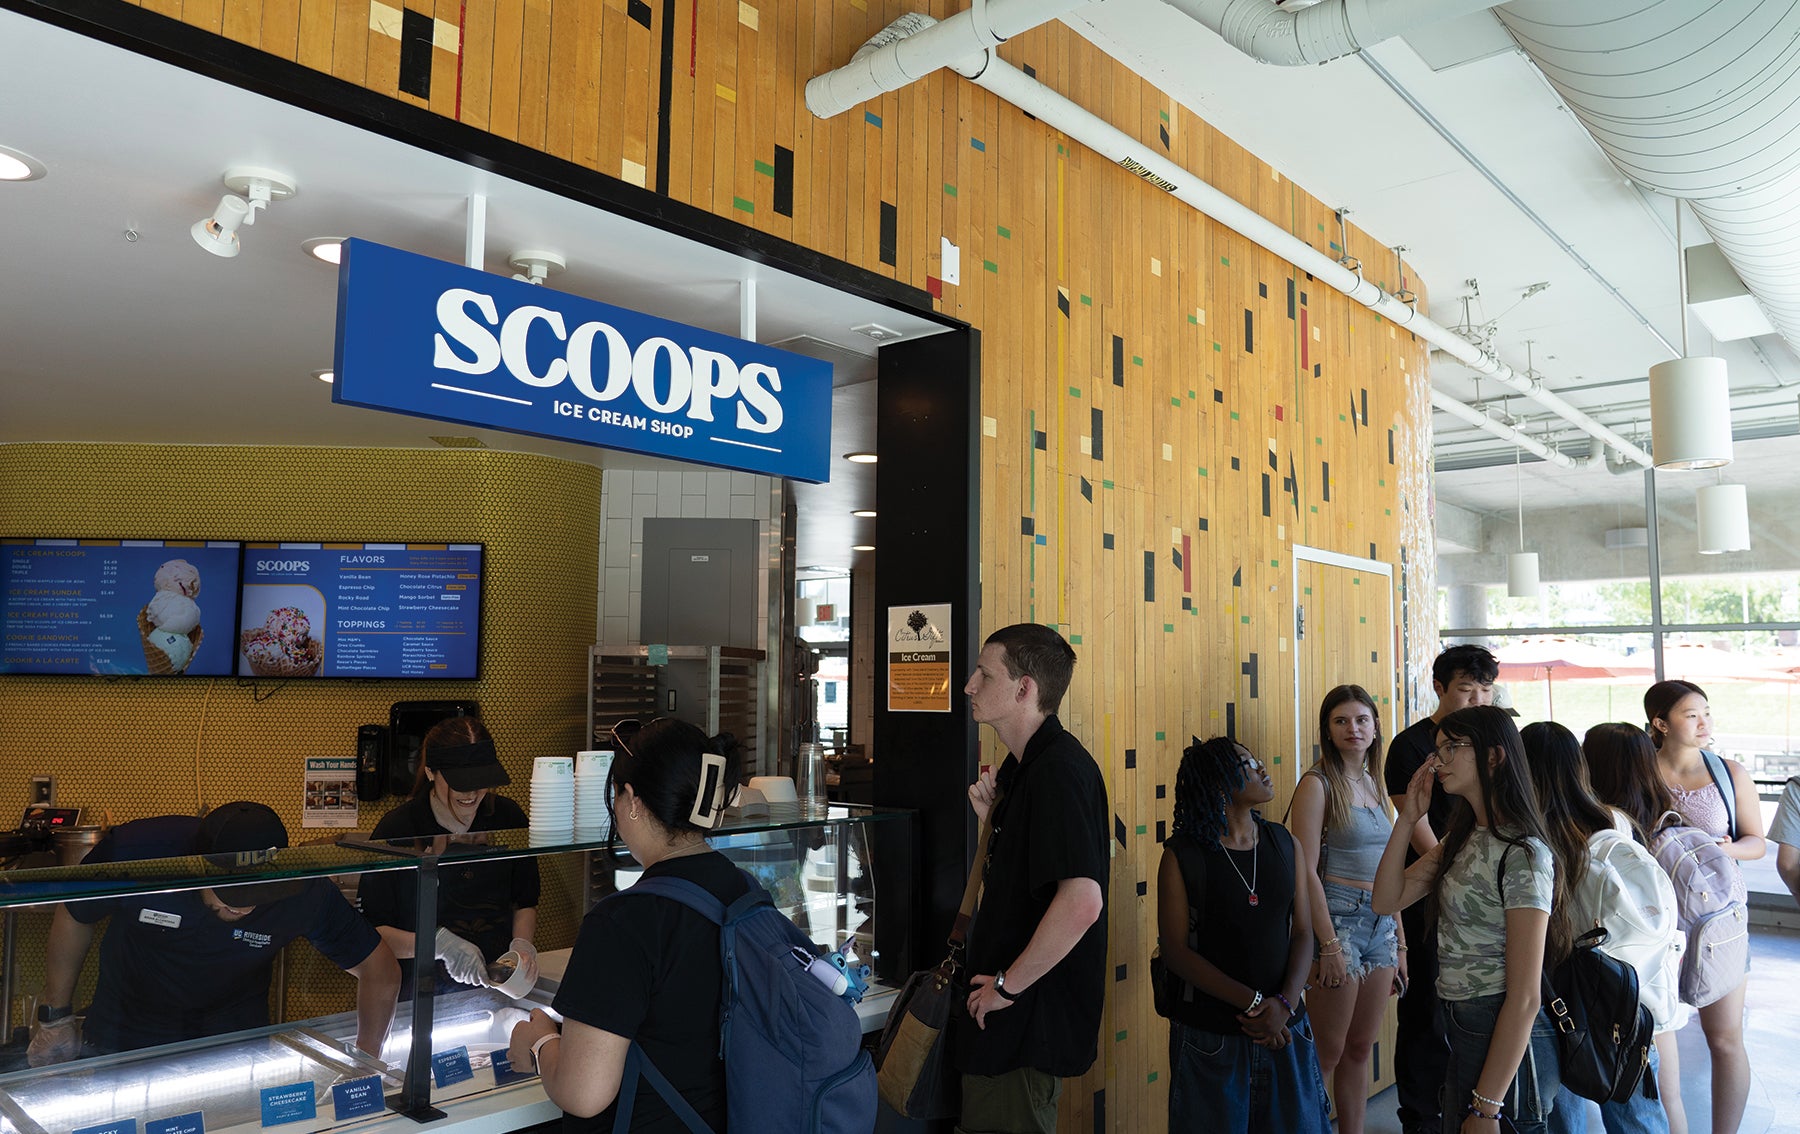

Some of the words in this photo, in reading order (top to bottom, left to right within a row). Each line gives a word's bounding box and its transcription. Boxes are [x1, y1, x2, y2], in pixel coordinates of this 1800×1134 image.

[433, 288, 783, 434] SCOOPS
[554, 400, 584, 419] ICE
[588, 407, 647, 430] CREAM
[651, 419, 694, 438] SHOP
[257, 560, 310, 571] SCOOPS
[337, 621, 386, 629] TOPPINGS
[902, 654, 911, 662] Ice
[912, 652, 936, 661] Cream
[310, 761, 326, 769] Wash
[326, 761, 339, 769] Your
[340, 761, 357, 769] Hands
[244, 931, 272, 941] RIVERSIDE
[438, 1053, 462, 1064] ESPRESSO
[345, 1085, 370, 1094] VANILLA
[268, 1091, 307, 1101] STRAWBERRY
[350, 1091, 367, 1100] BEAN
[270, 1096, 307, 1107] CHEESECAKE
